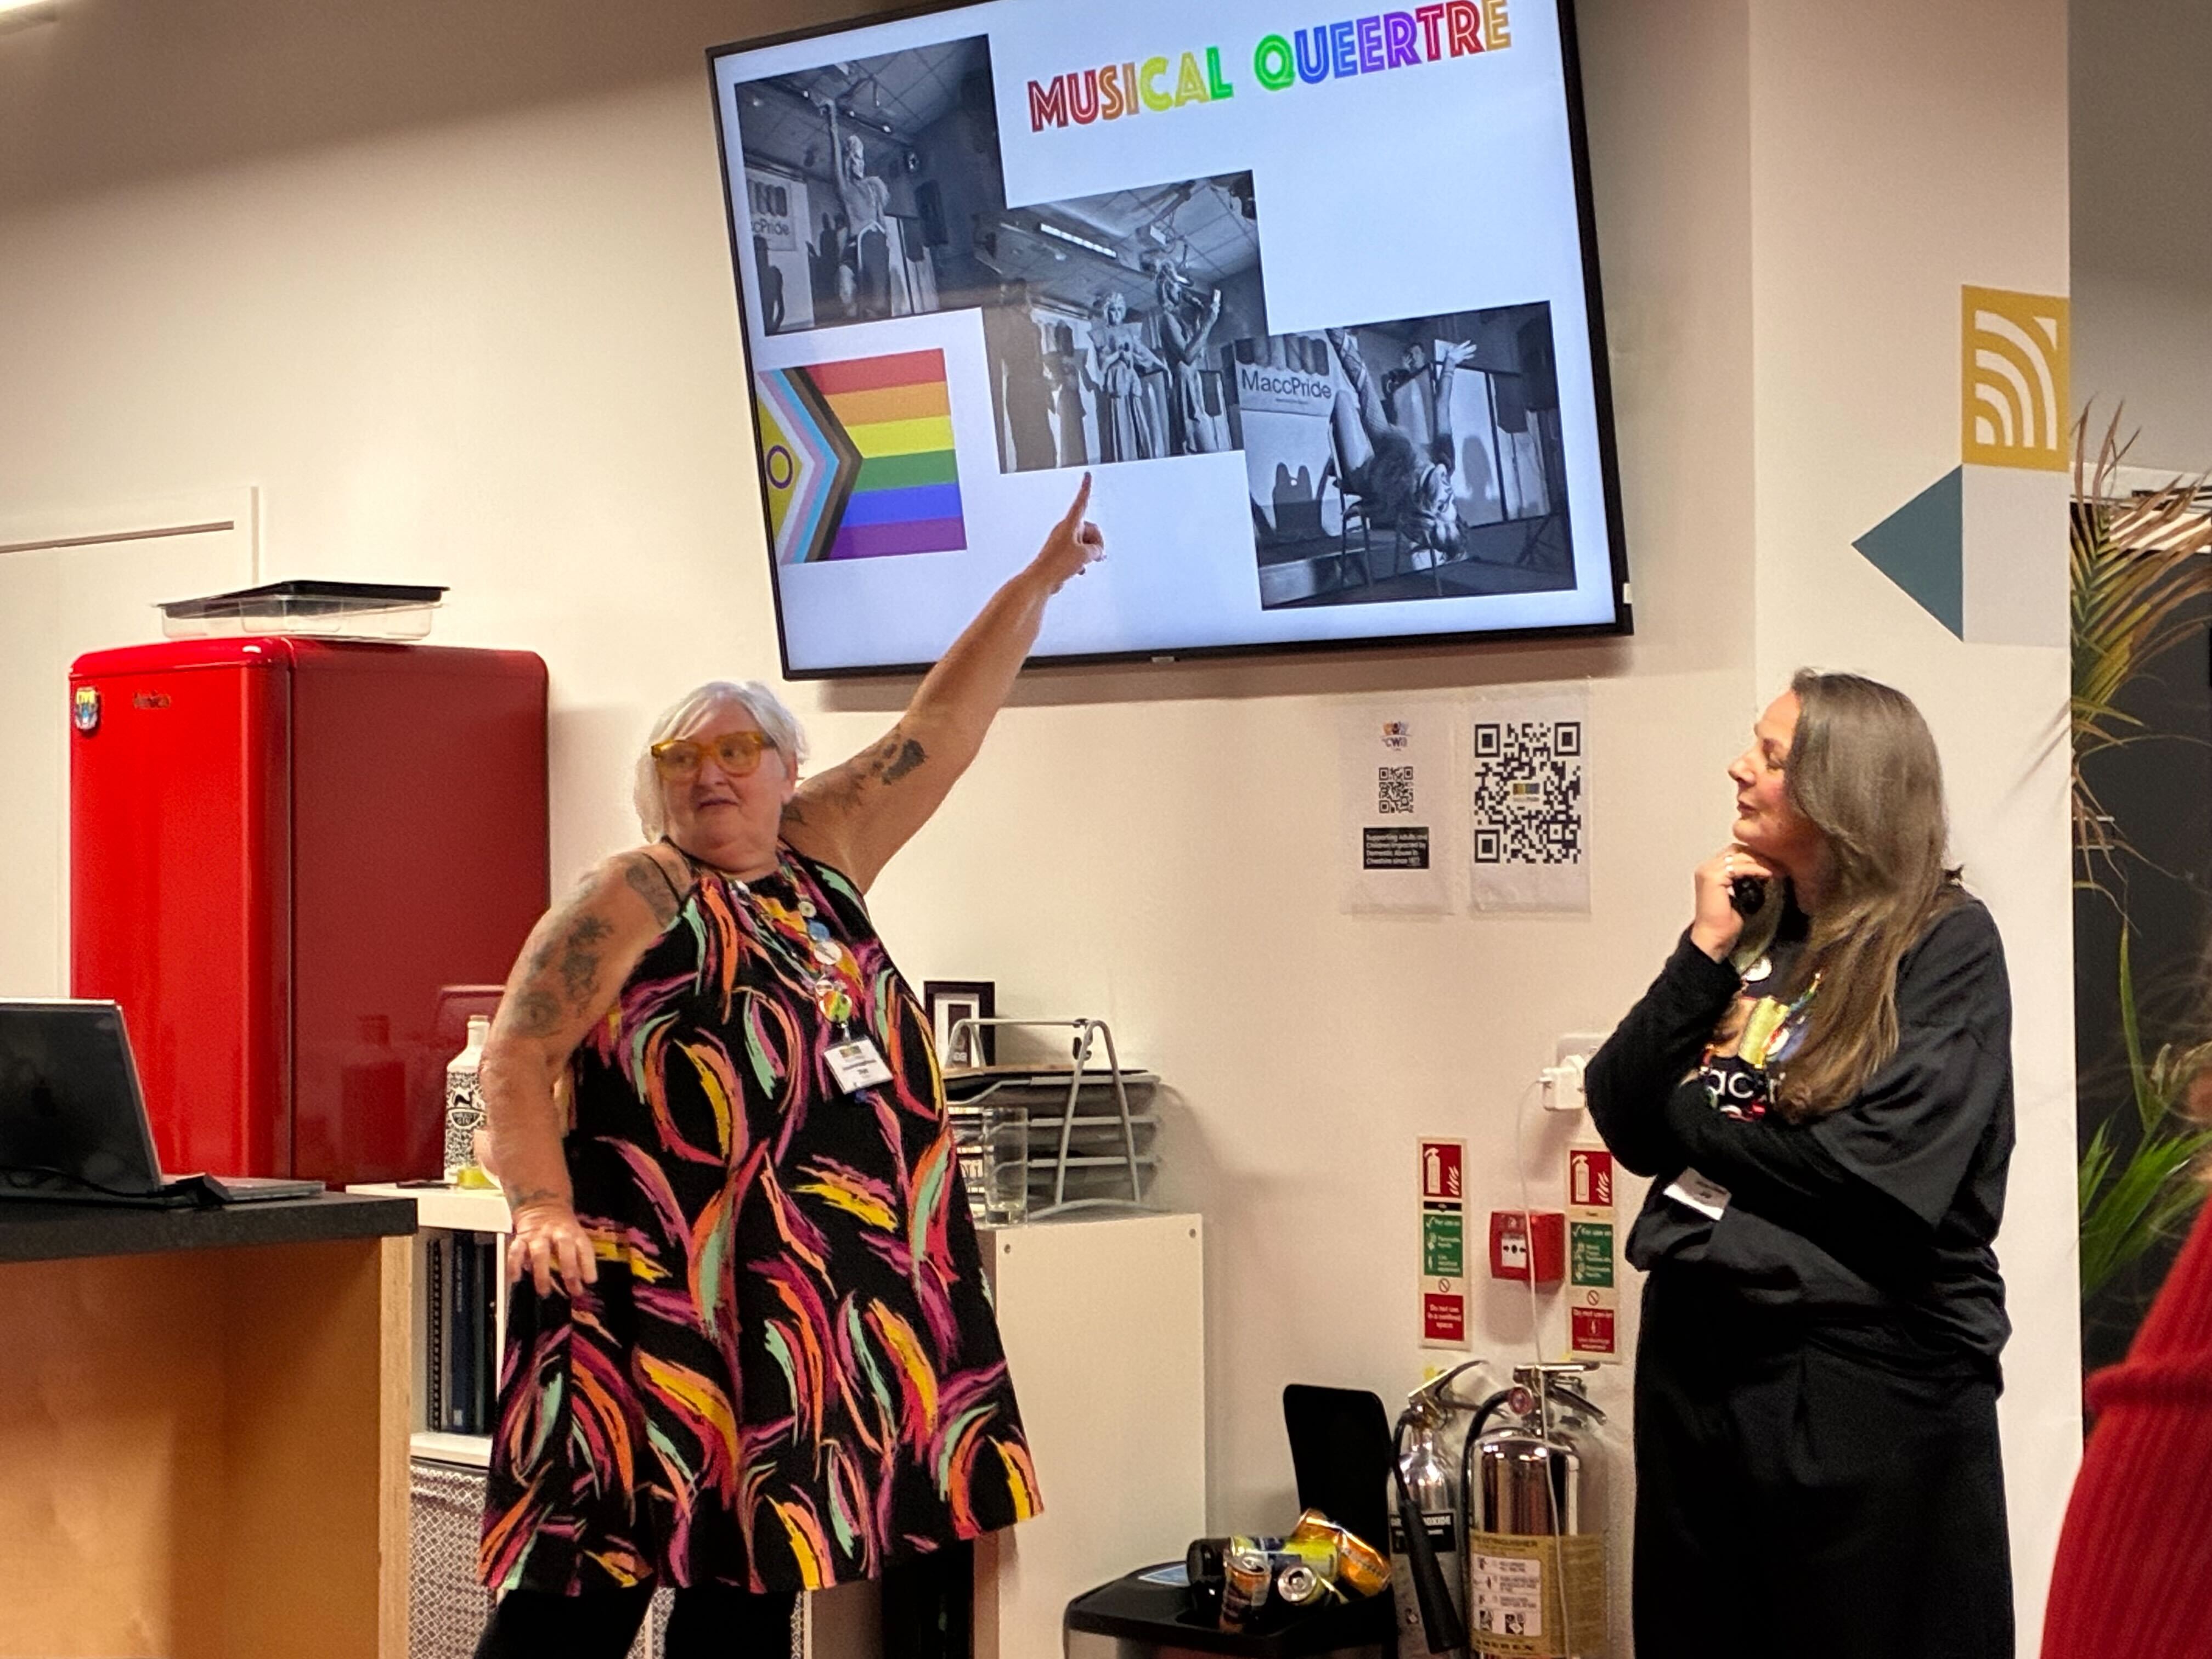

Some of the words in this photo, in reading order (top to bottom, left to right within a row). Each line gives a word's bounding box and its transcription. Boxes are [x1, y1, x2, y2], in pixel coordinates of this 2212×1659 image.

[1027, 46, 1234, 133] MUSICAL
[1254, 0, 1512, 91] QUEERTRE
[1242, 368, 1332, 400] MaccPride
